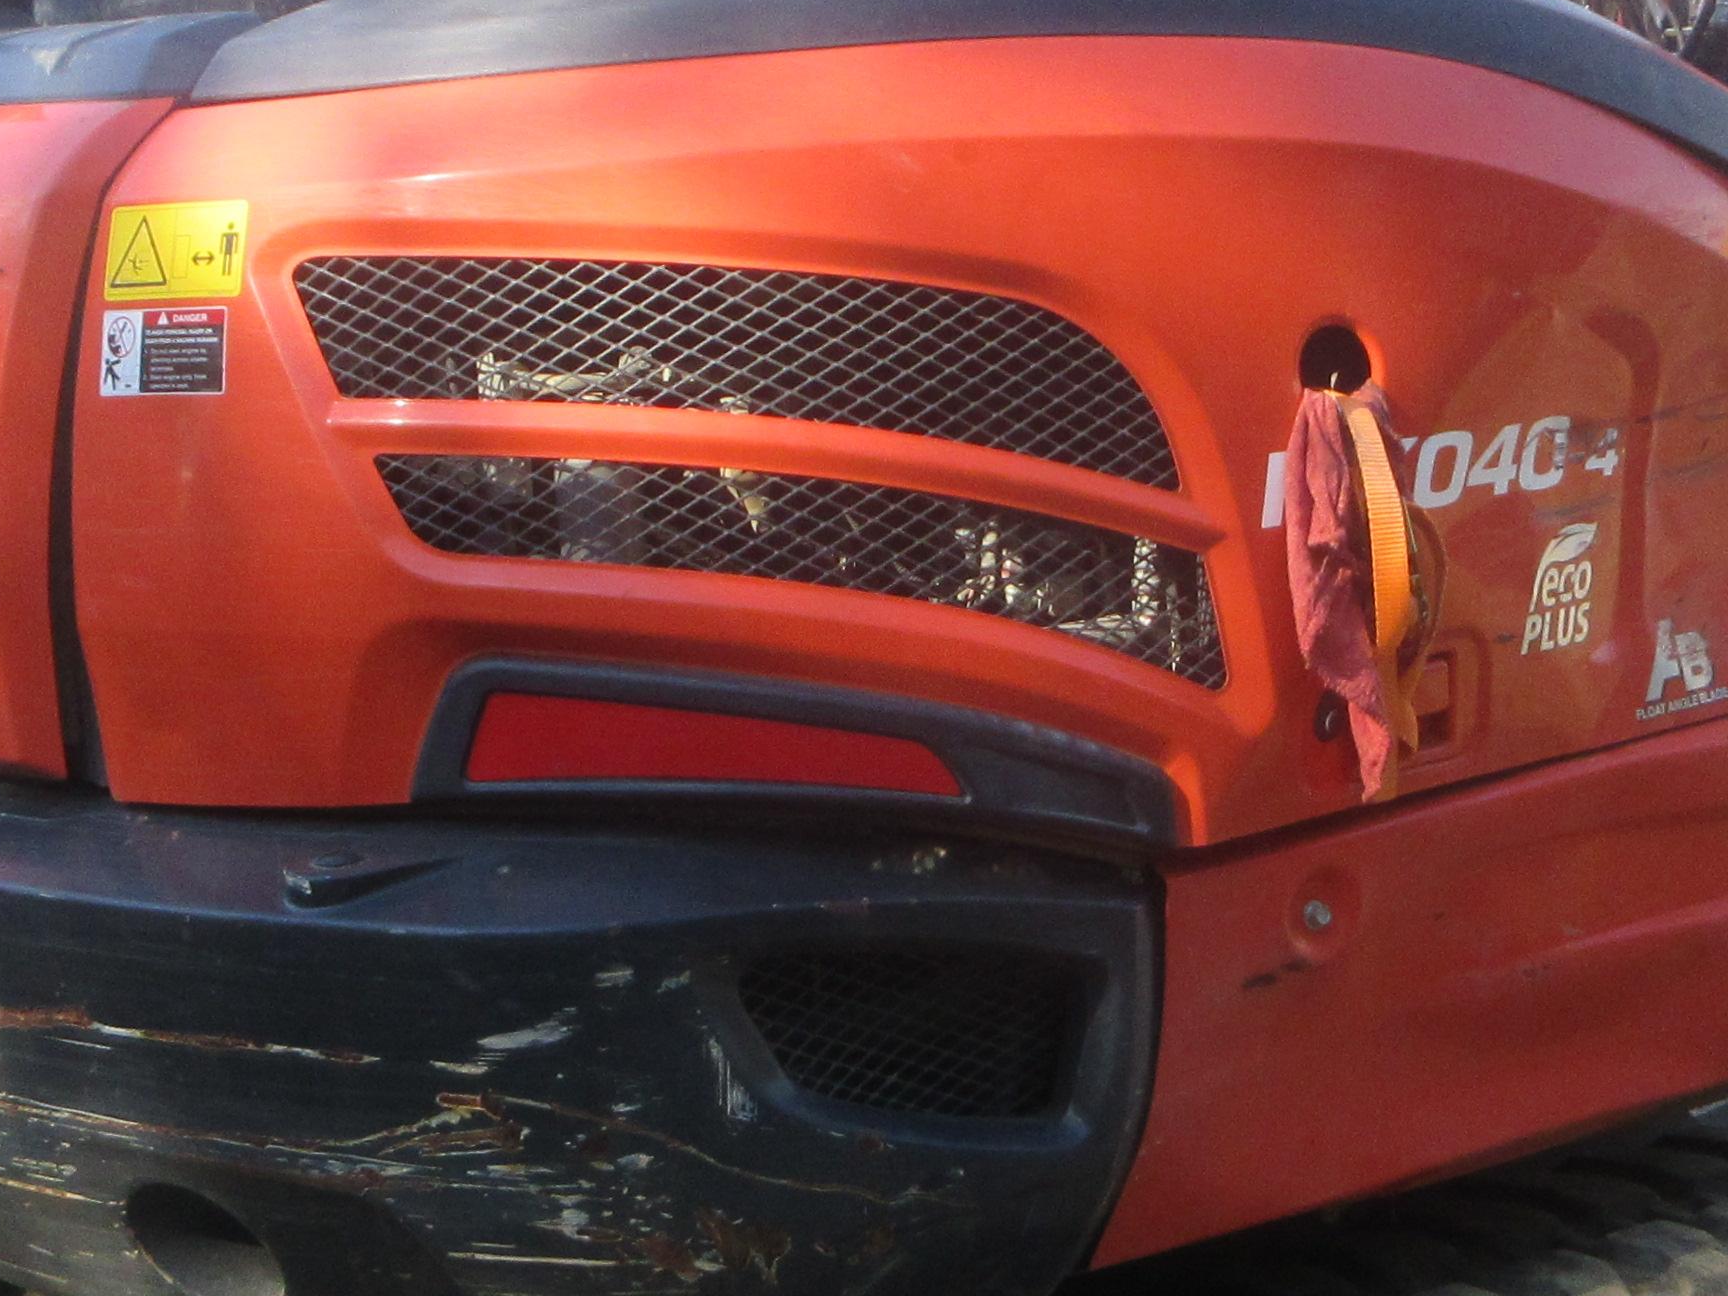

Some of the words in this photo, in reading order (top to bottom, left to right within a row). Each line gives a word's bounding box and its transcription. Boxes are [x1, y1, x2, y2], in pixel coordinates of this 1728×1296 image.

[173, 312, 208, 323] DANGER
[1521, 601, 1591, 656] PLUS
[1636, 702, 1668, 721] FLOAT
[1668, 693, 1700, 713] ANGLE
